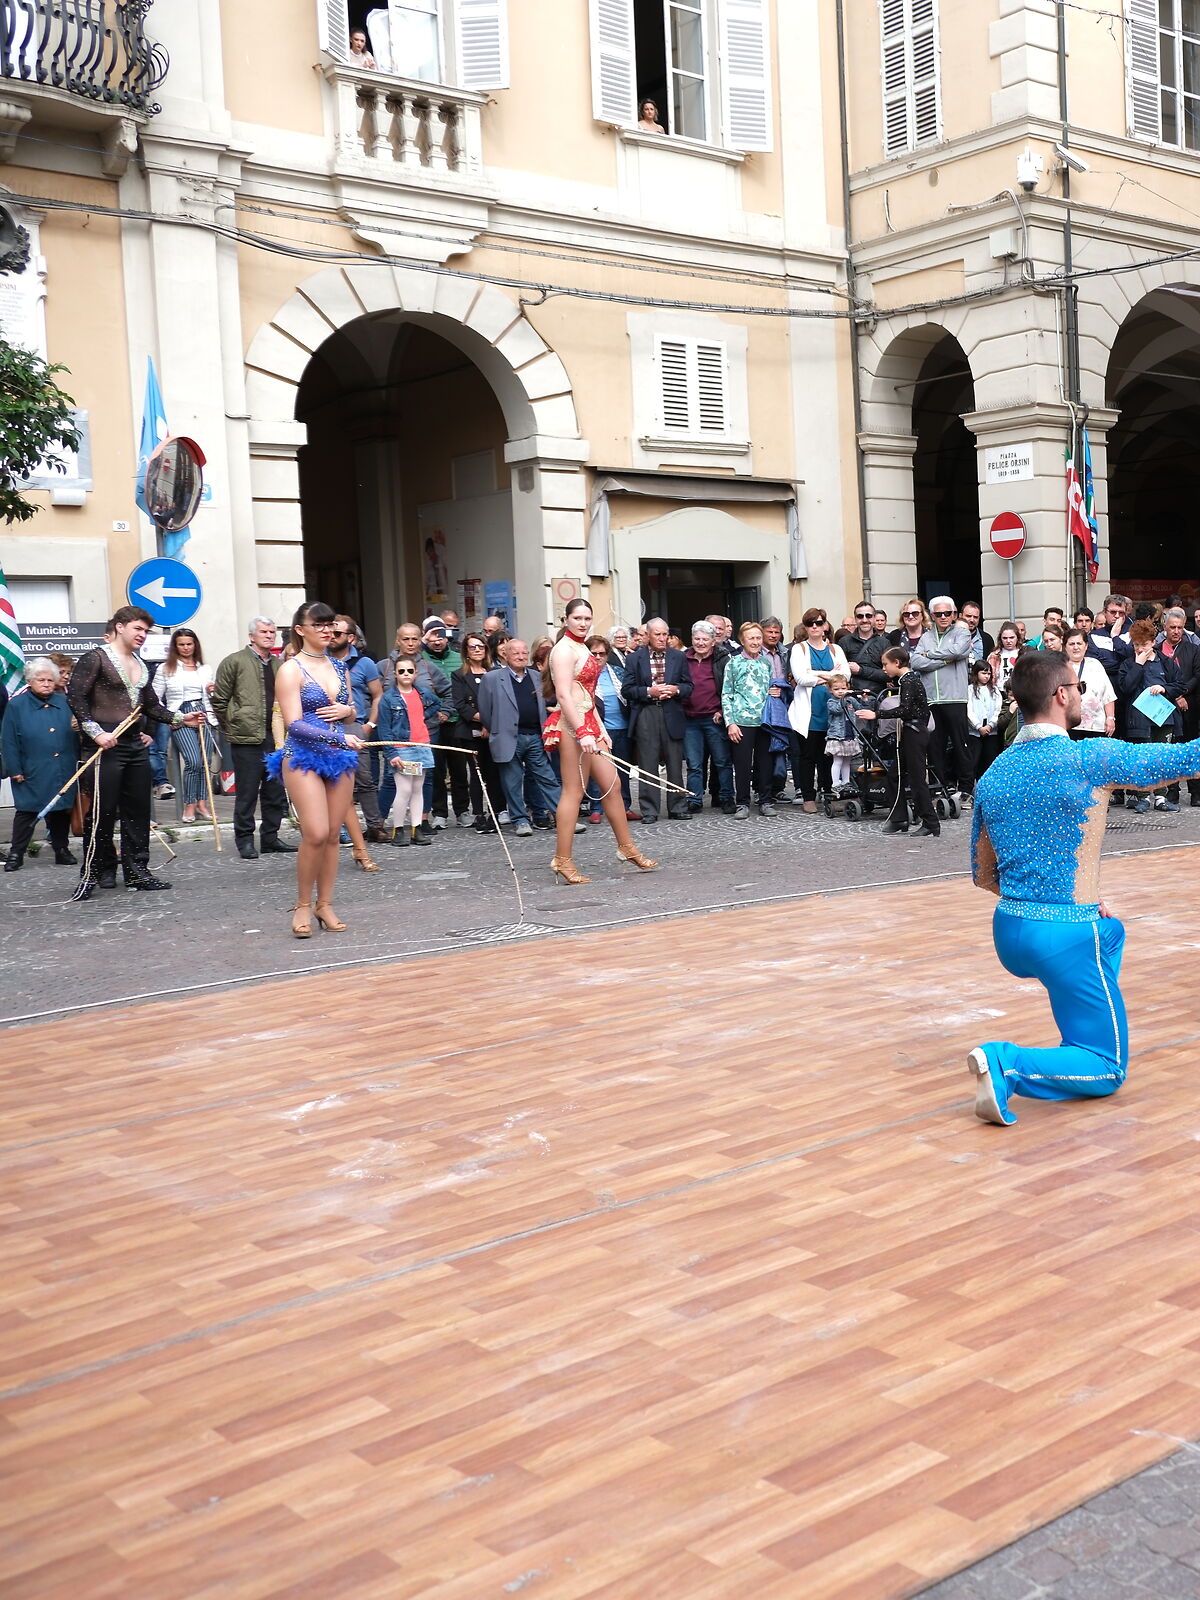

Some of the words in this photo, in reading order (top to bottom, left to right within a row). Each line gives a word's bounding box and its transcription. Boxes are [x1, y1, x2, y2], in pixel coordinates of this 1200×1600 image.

[1000, 452, 1017, 460] PIAZZA
[988, 460, 1009, 470] FELICE
[1010, 457, 1030, 467] ORSINI
[117, 522, 126, 530] 30
[26, 626, 78, 636] Municipio
[21, 643, 43, 652] atro
[45, 641, 99, 651] Comunale
